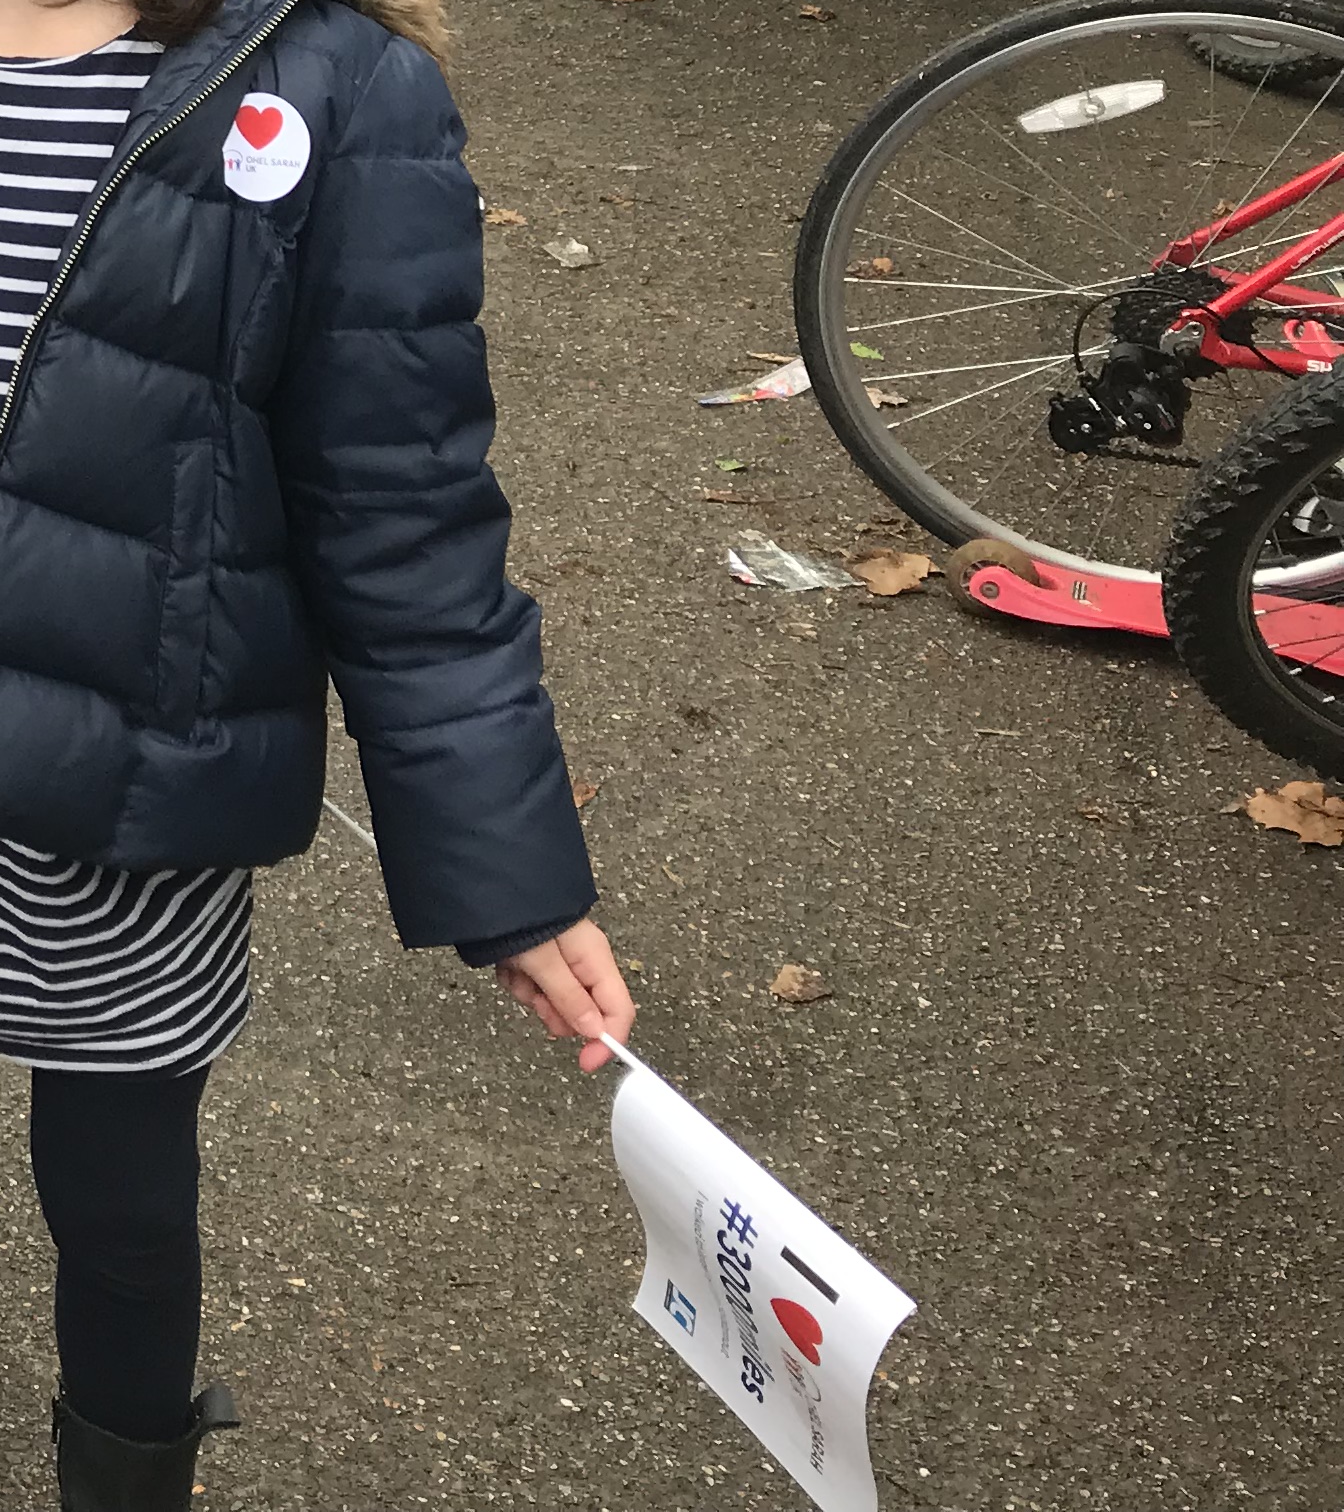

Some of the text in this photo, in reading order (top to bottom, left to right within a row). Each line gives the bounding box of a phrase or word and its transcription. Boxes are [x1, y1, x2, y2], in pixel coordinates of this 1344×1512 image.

[245, 164, 257, 173] UK
[246, 156, 301, 169] OHEL SARAH
[780, 1245, 841, 1306] I
